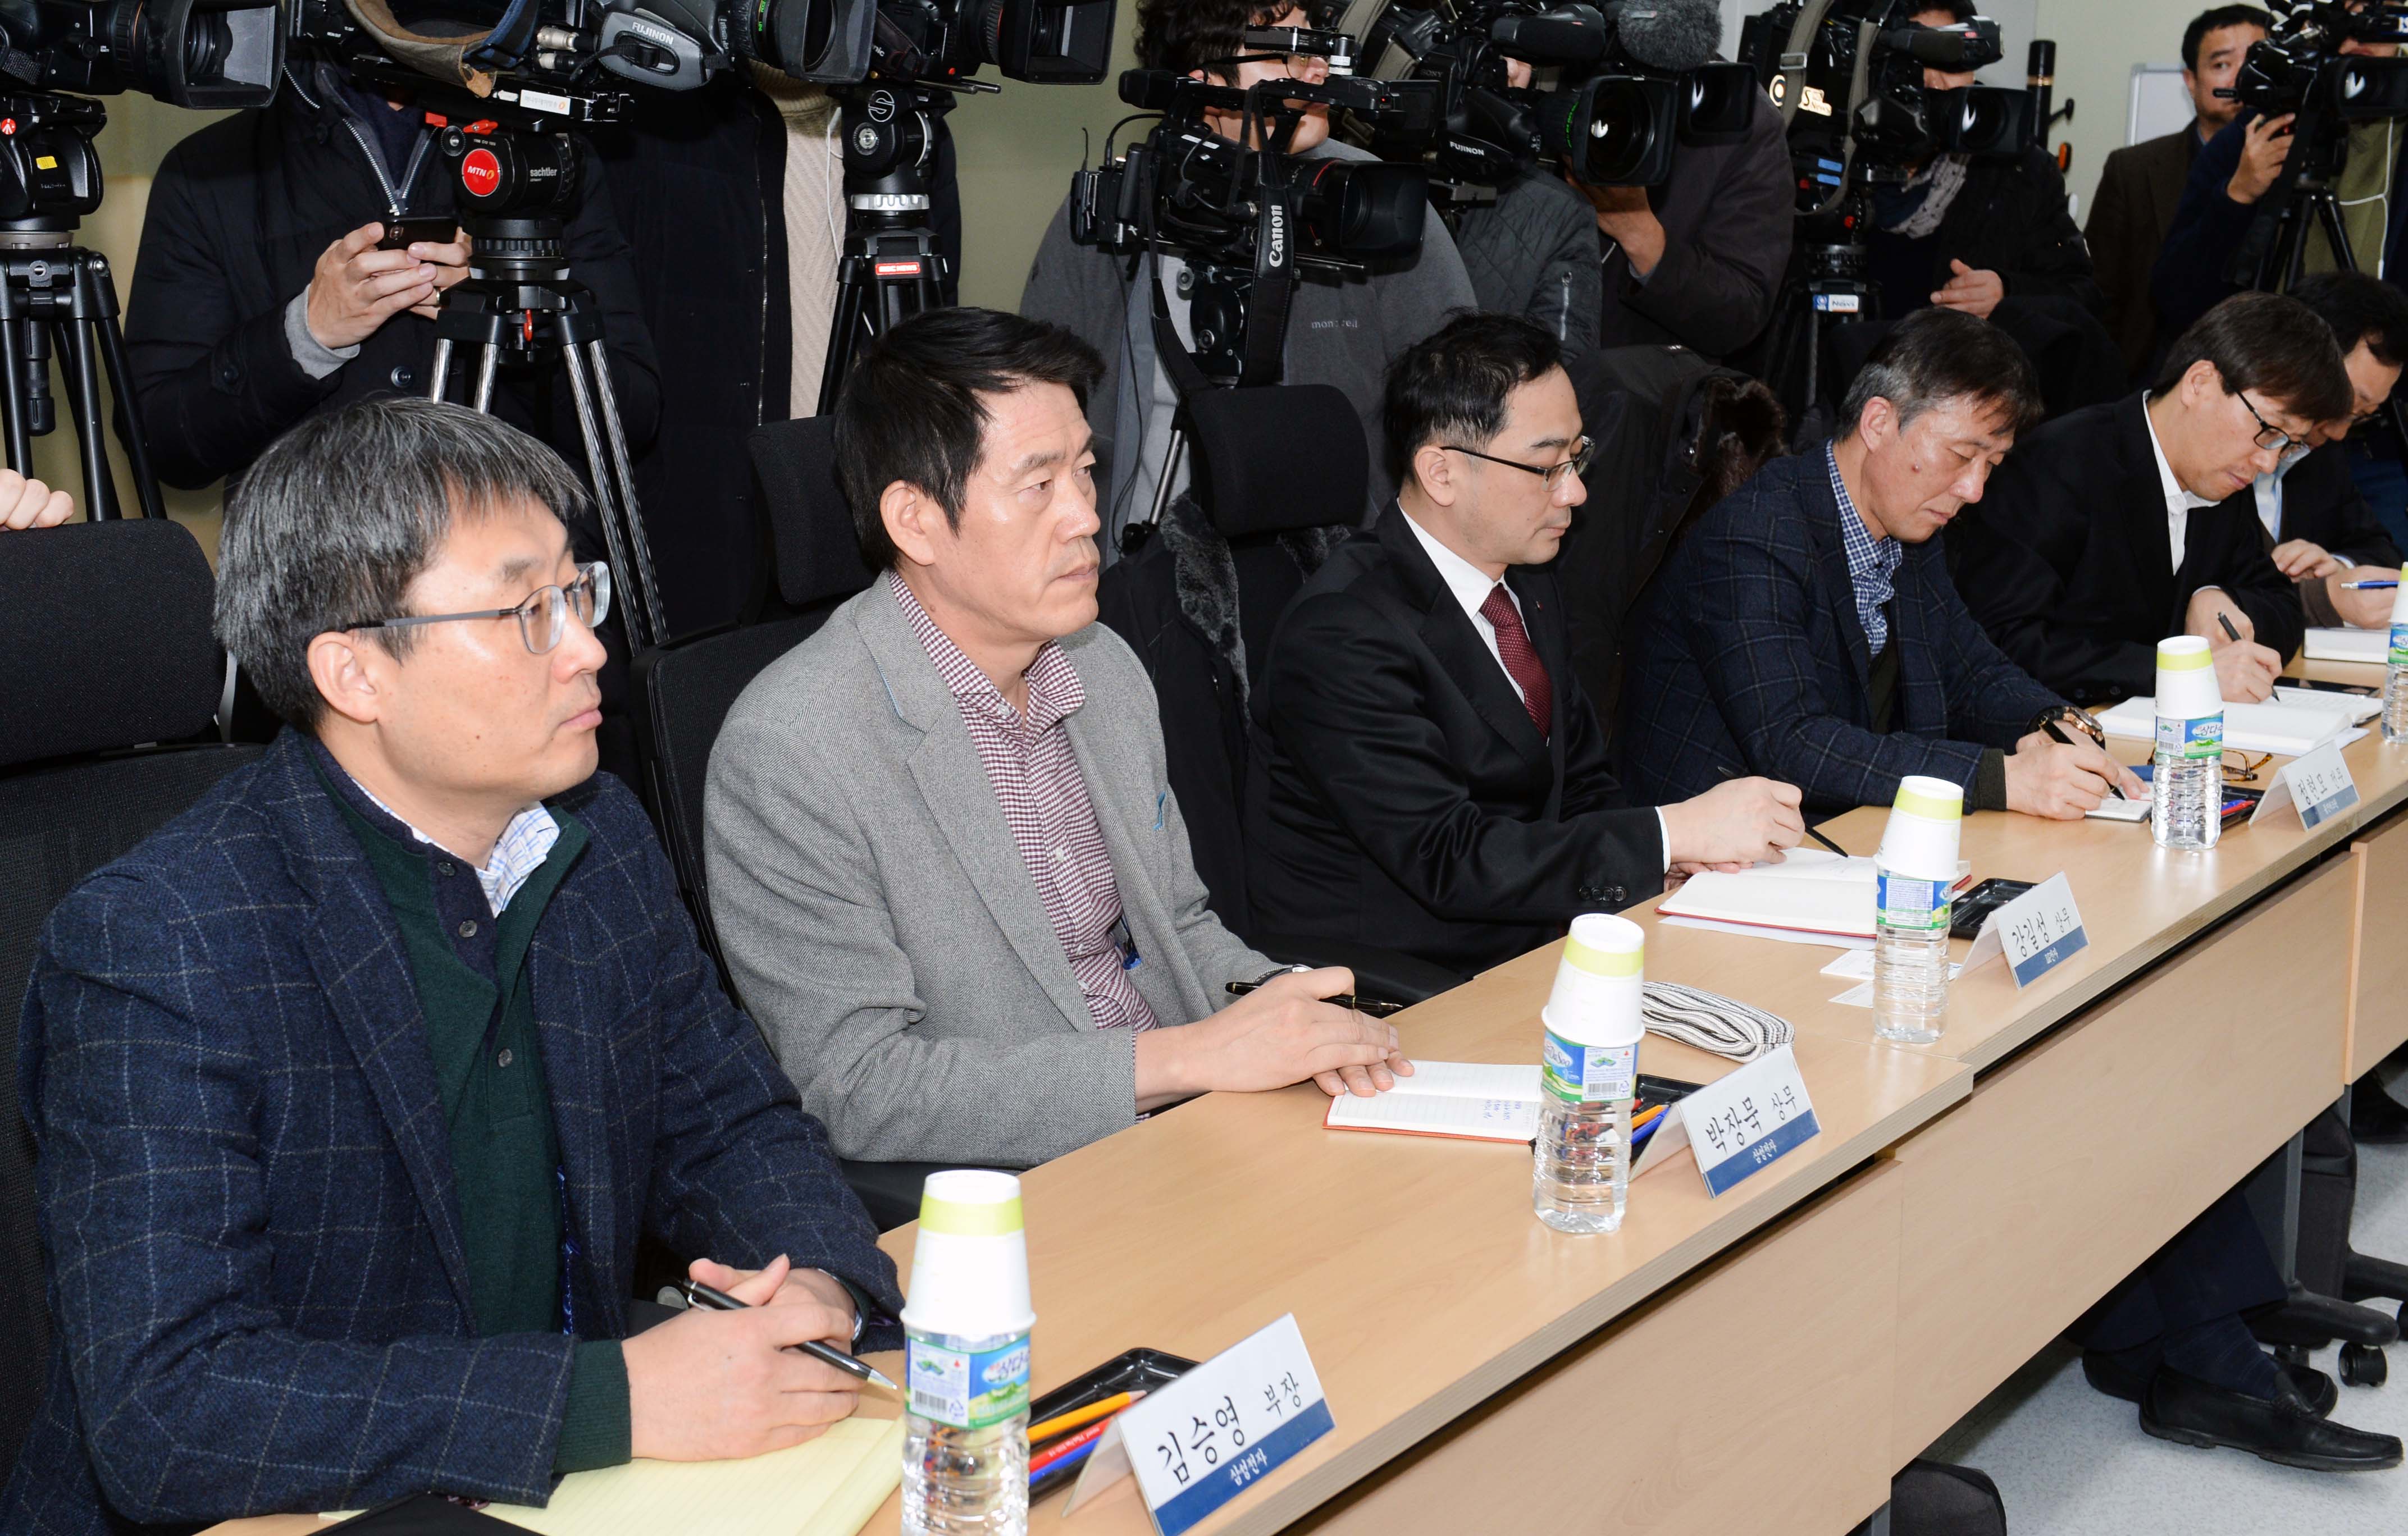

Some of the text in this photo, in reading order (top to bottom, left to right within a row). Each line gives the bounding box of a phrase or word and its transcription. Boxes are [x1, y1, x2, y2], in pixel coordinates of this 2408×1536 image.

[632, 22, 674, 45] FUJINON
[1450, 141, 1484, 156] FUJINON
[467, 166, 487, 177] MTN
[530, 167, 557, 177] sachtler
[1269, 205, 1283, 267] Canon
[2012, 908, 2071, 957] 강길성 상무
[1706, 1086, 1797, 1155] 박장묵 상무
[1753, 1139, 1777, 1164] 삼성전자
[1157, 1372, 1301, 1485] 김승영 부장
[1230, 1447, 1267, 1486] 삼성전자
